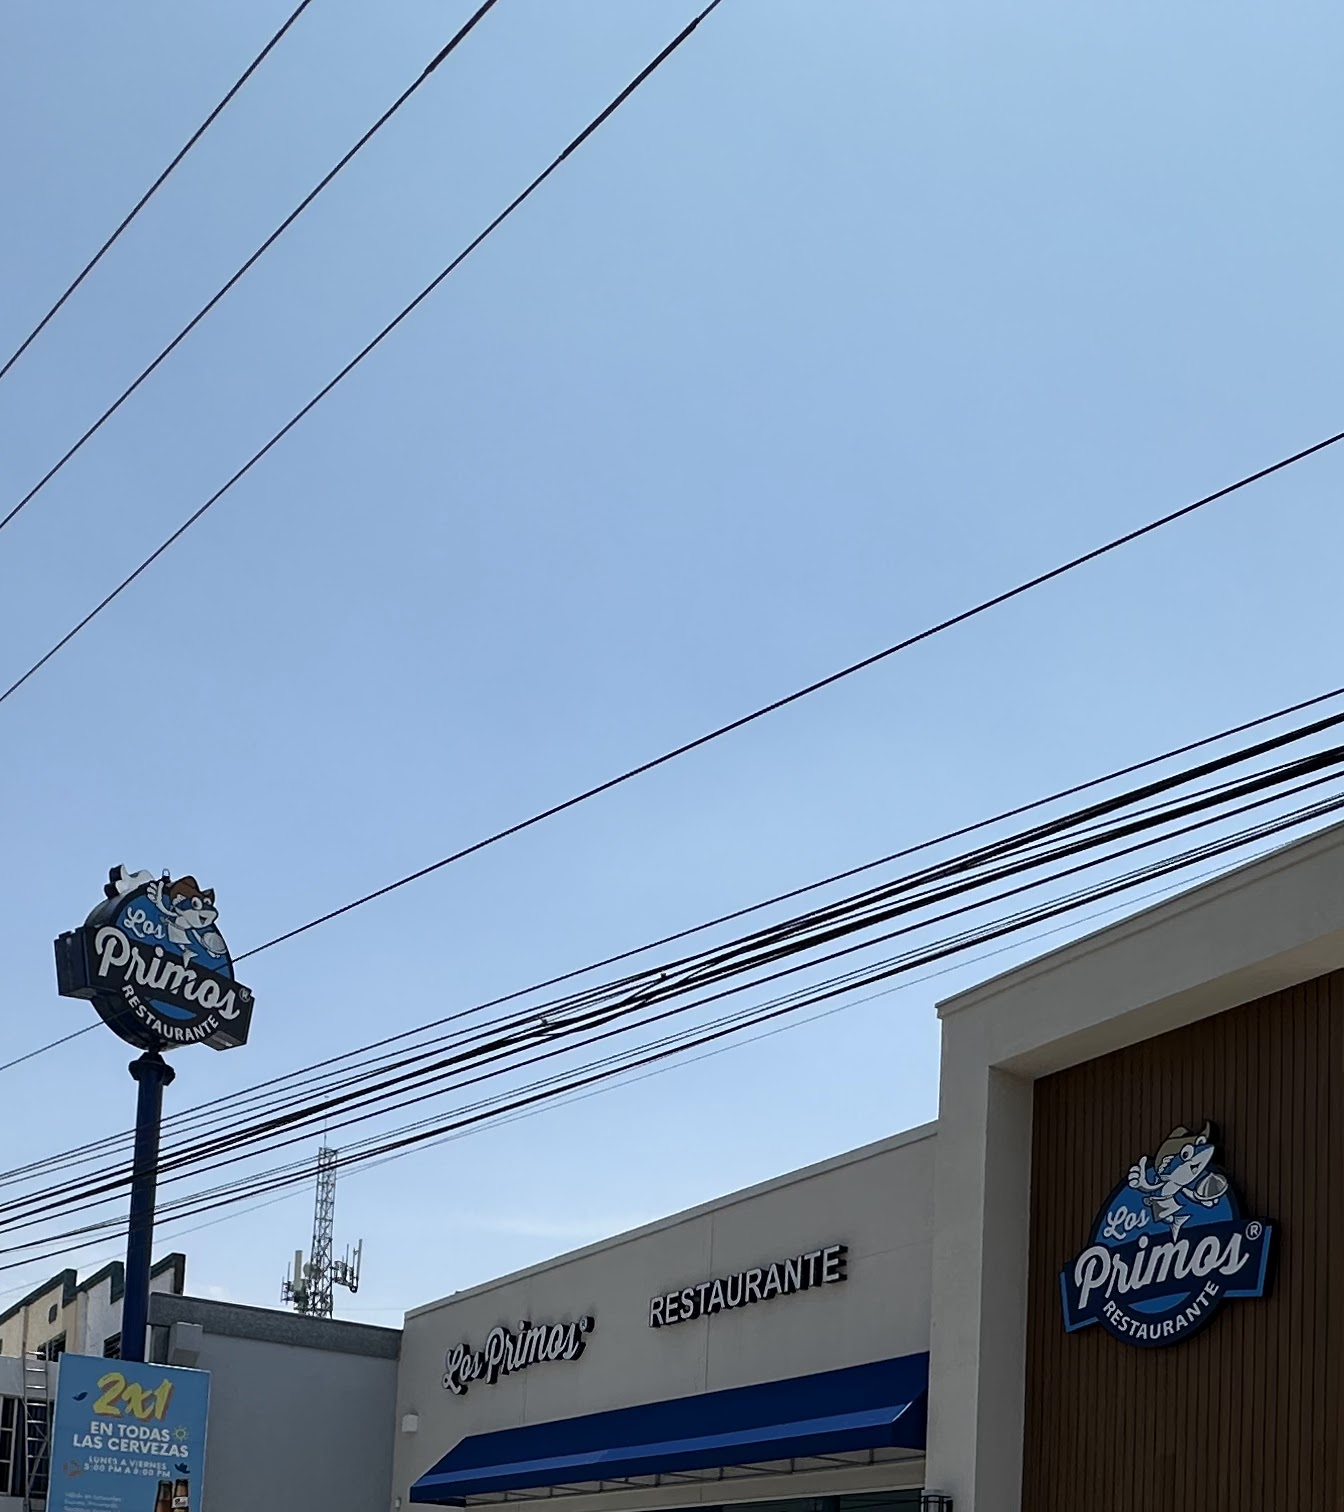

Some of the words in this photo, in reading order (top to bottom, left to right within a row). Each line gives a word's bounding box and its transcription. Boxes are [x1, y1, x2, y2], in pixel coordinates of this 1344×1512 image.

[123, 906, 166, 938] Los
[121, 984, 219, 1041] RESTAURANTE
[1103, 1205, 1150, 1240] Los
[648, 1244, 845, 1328] RESTAURANTE
[1102, 1280, 1219, 1340] RESTAURANTE
[442, 1343, 484, 1395] Los
[92, 1371, 174, 1422] 2x1
[73, 1434, 103, 1450] LAS
[107, 1438, 189, 1458] CERVEZAS
[90, 1421, 113, 1436] EN
[118, 1423, 171, 1442] TODAS
[89, 1455, 118, 1466] LUNES
[130, 1459, 167, 1471] VIERNES
